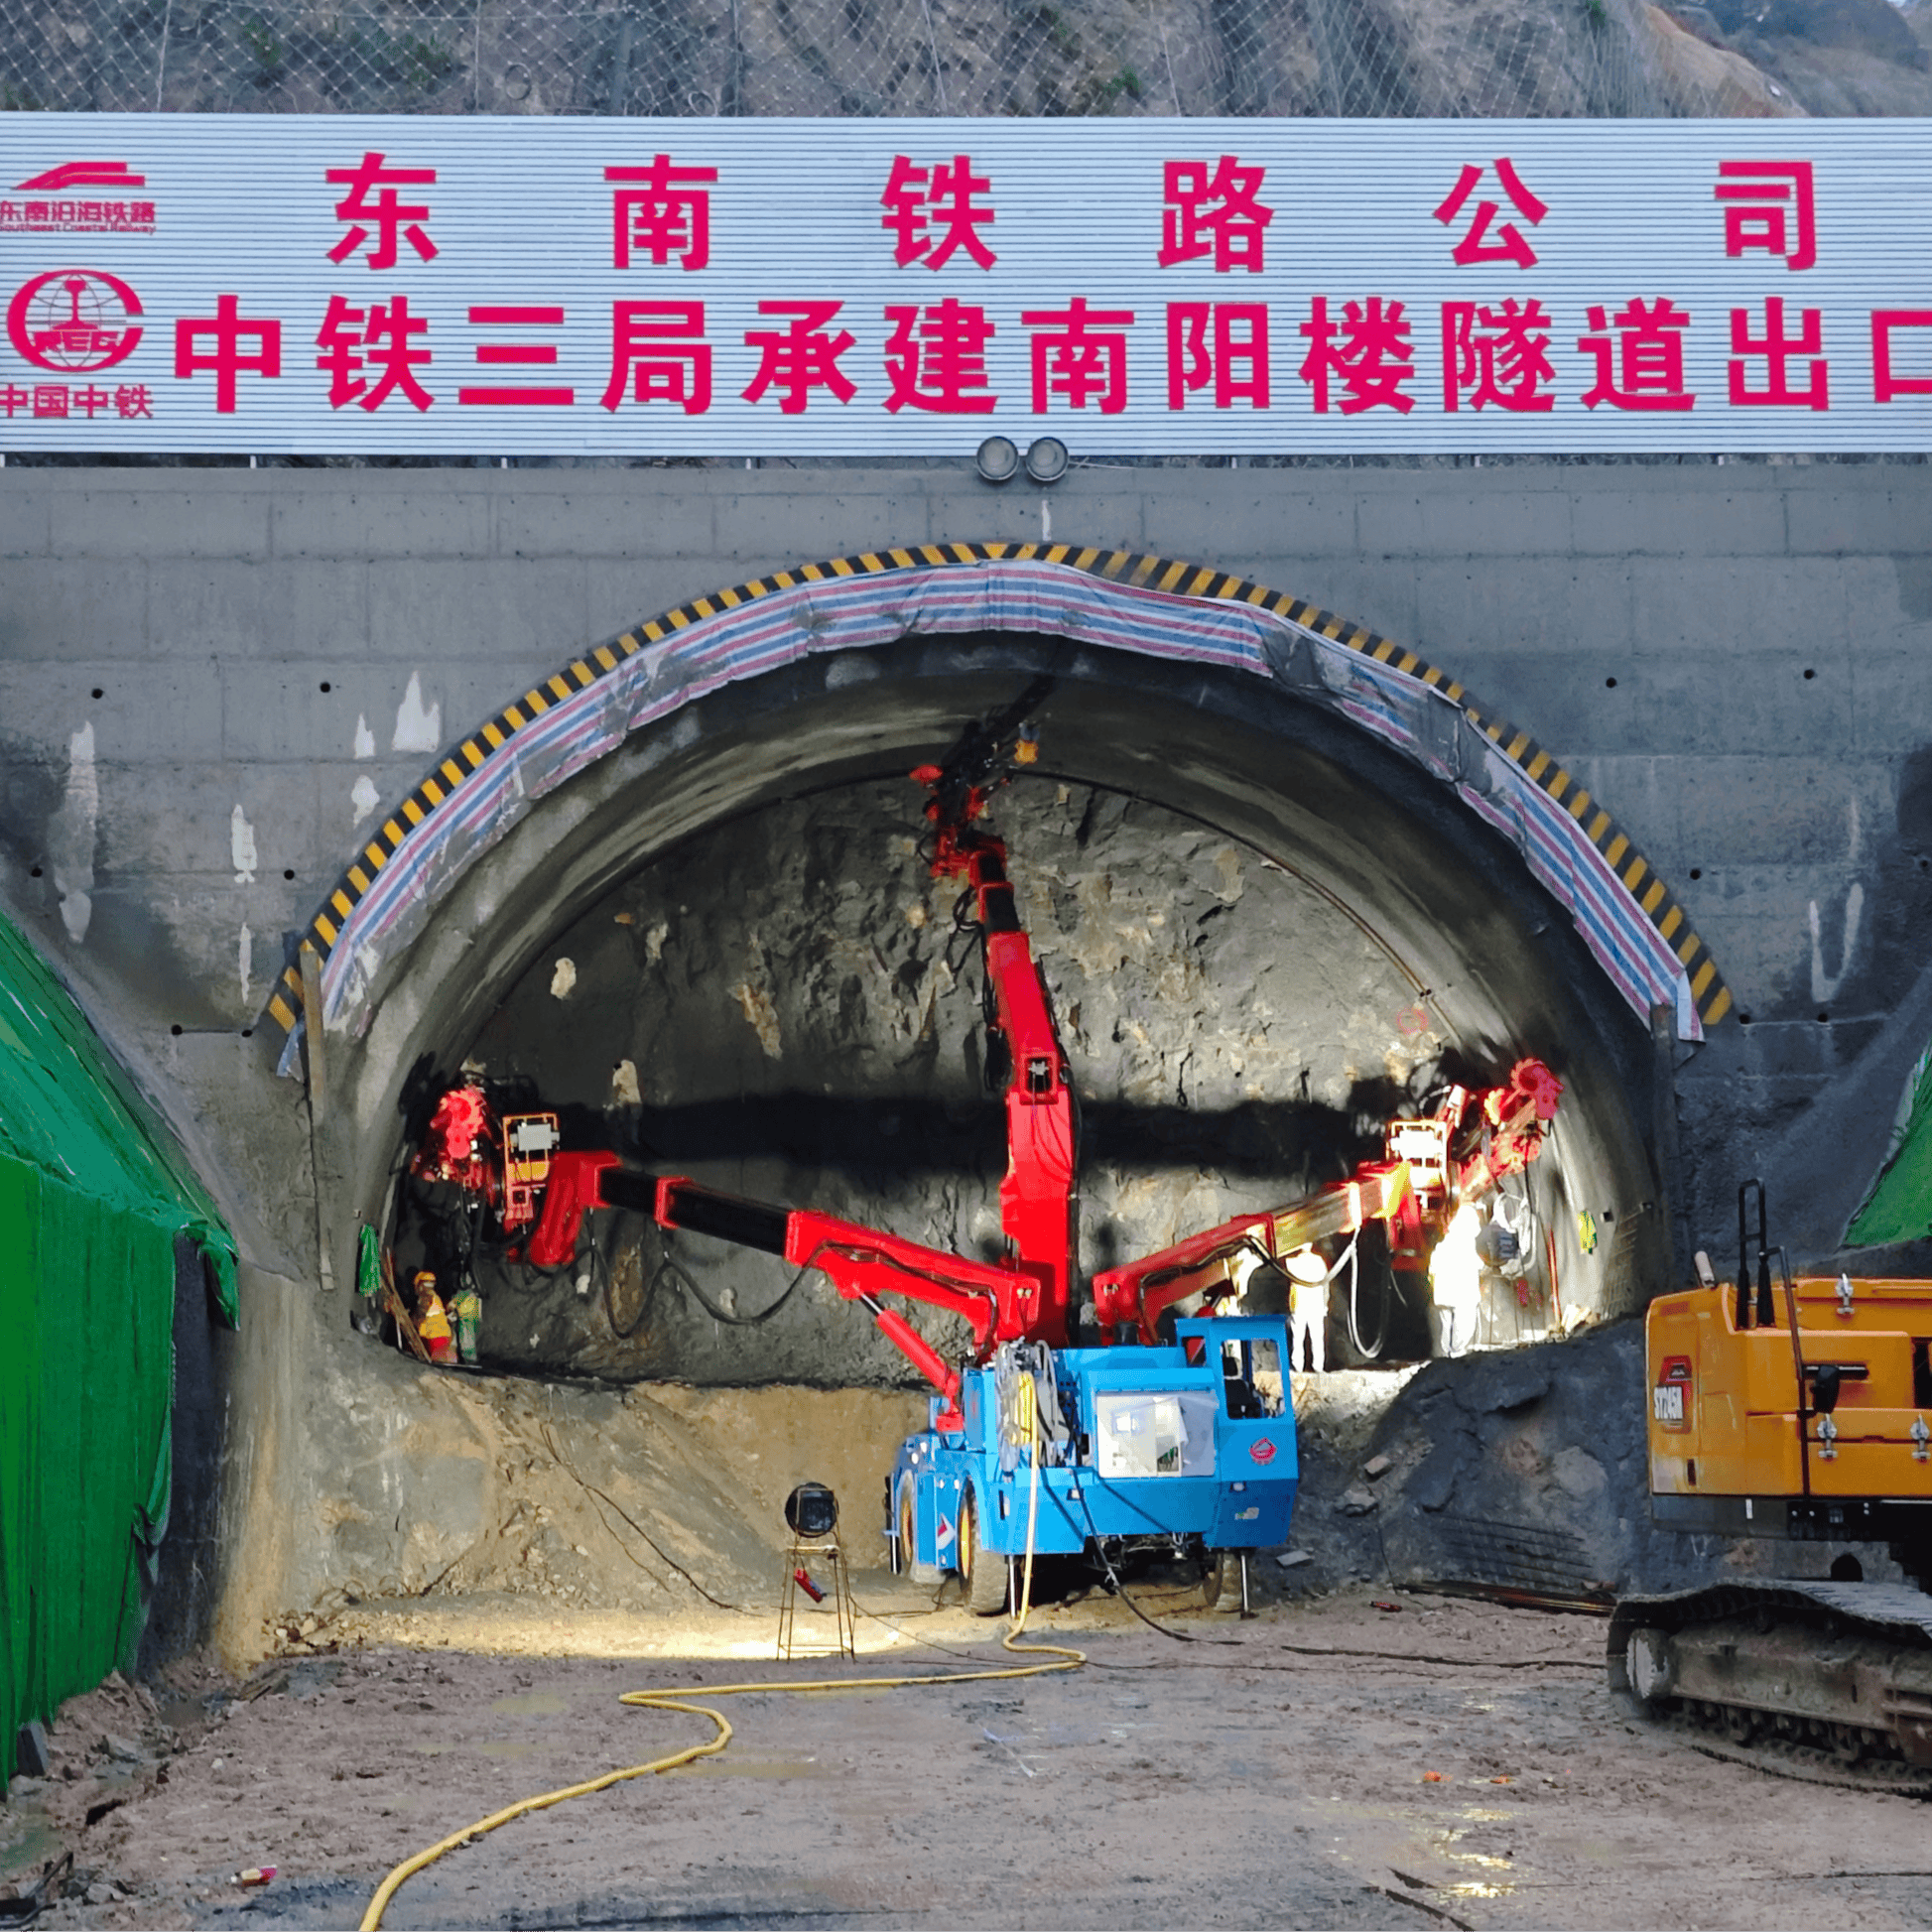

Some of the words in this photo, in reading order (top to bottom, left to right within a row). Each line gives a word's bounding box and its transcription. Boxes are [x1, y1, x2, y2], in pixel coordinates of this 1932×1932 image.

[325, 151, 1817, 273] 东南铁路公司
[0, 383, 153, 419] 中国中铁
[174, 295, 1932, 416] 中铁三局承建南阳楼隧道出口
